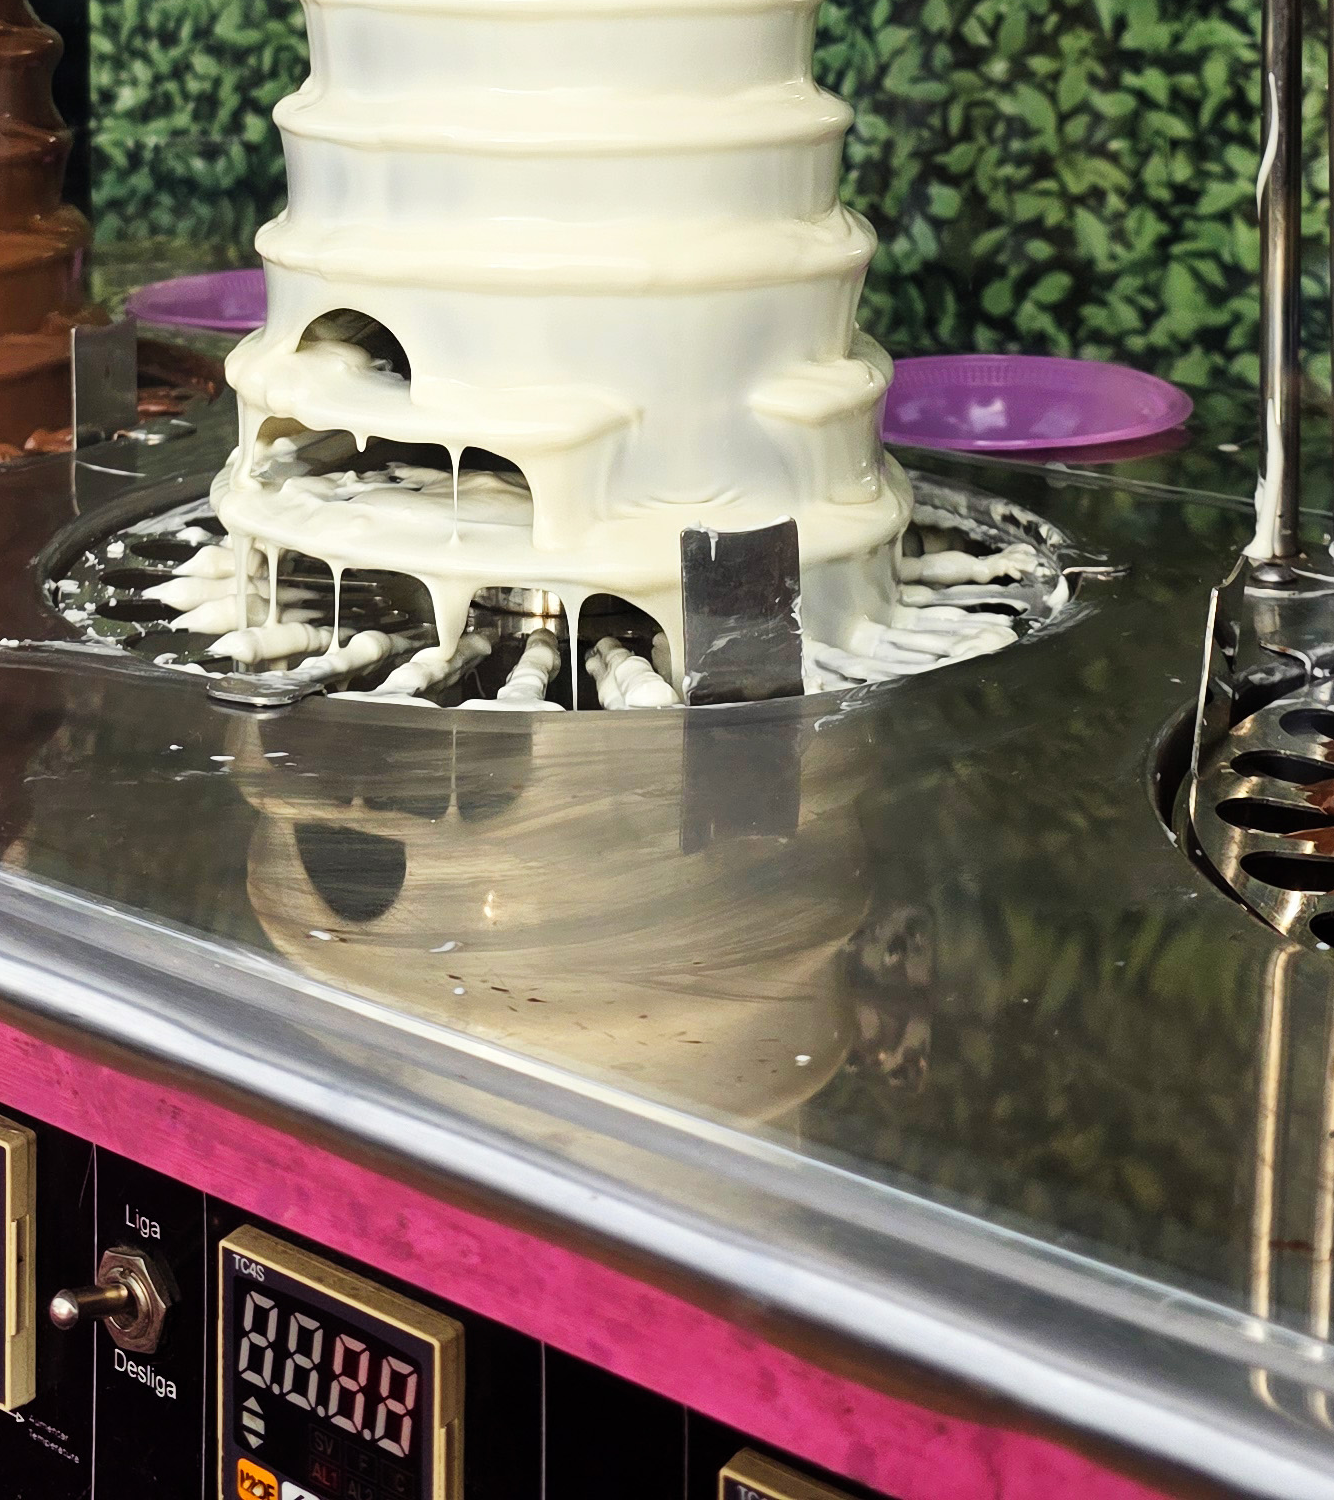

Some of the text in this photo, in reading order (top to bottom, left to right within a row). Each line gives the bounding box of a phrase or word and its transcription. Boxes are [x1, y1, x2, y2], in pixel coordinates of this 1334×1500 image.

[125, 1204, 161, 1240] Liga
[232, 1254, 265, 1282] TC4S
[114, 1349, 177, 1400] Desliga
